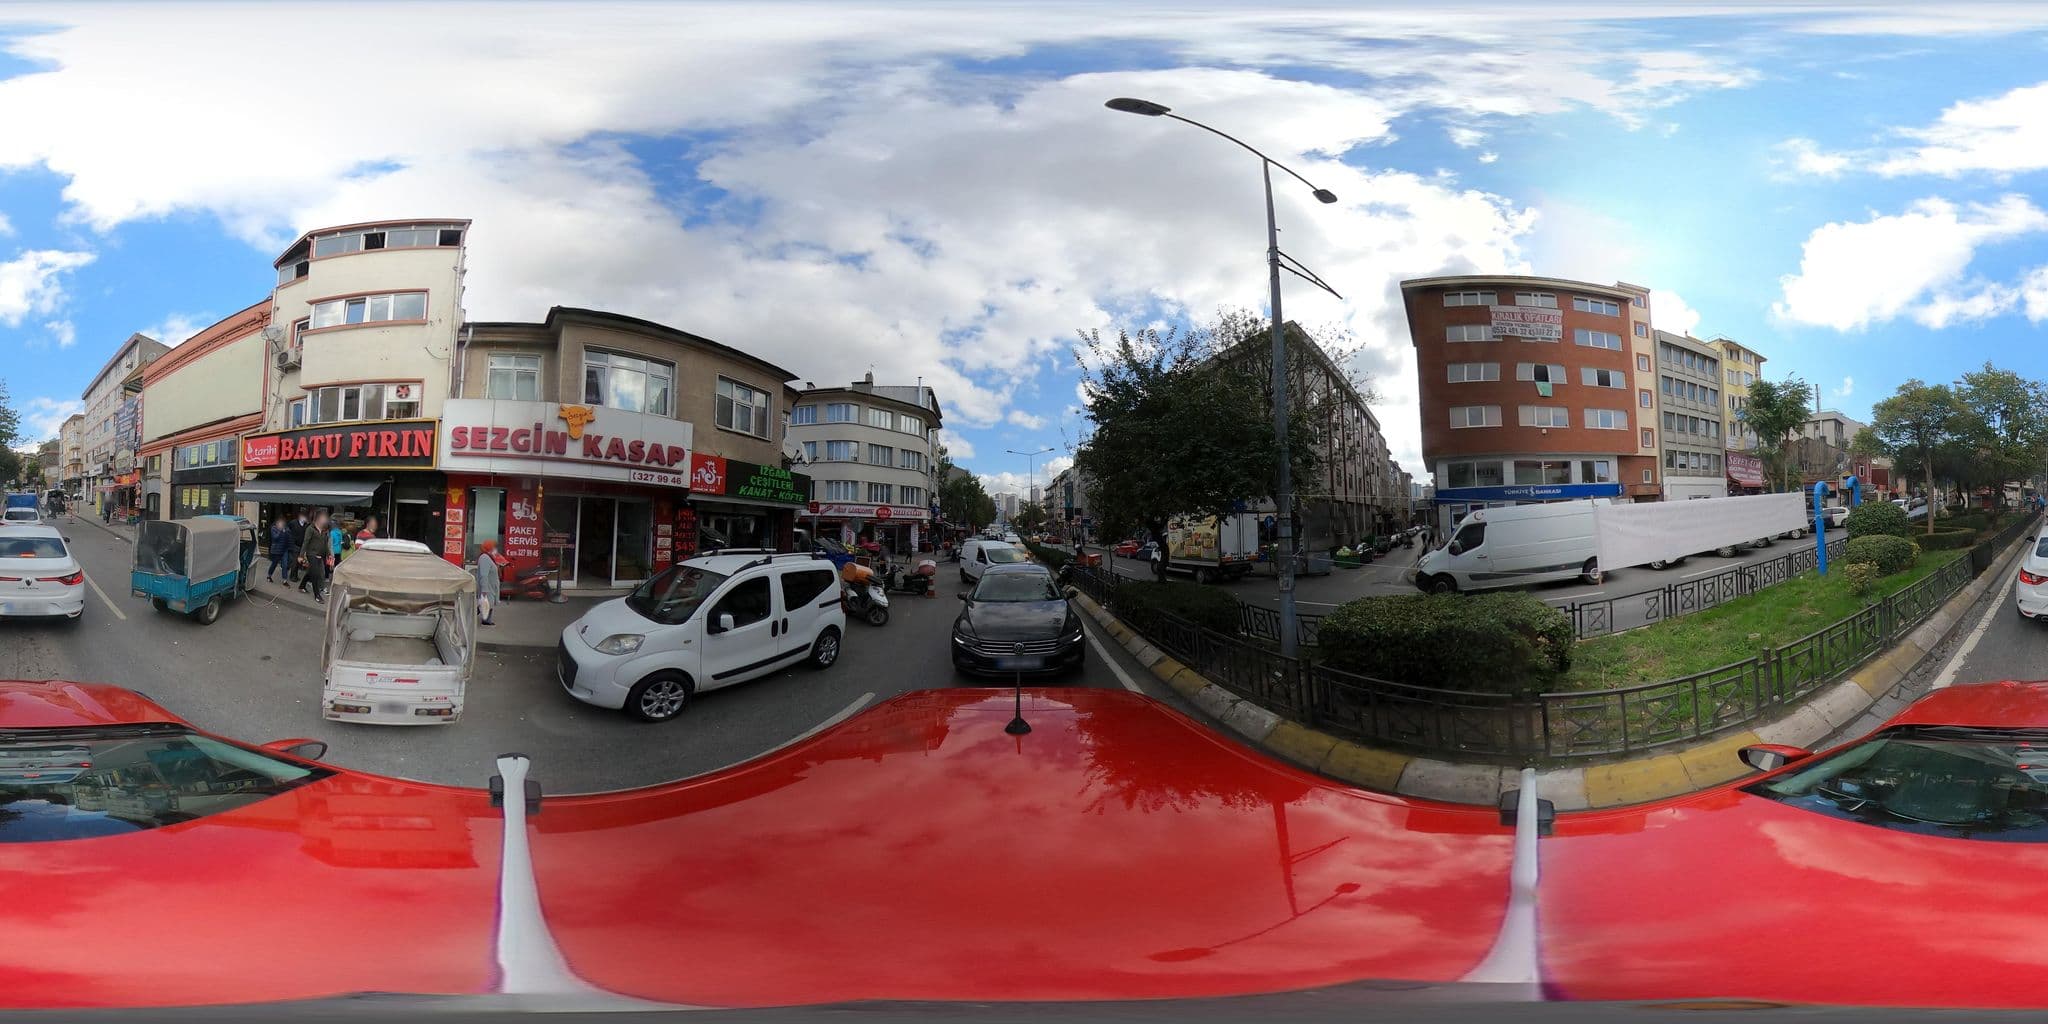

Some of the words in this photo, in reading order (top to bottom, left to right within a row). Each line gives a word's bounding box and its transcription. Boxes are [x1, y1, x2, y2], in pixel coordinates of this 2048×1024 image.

[280, 433, 342, 461] BATU
[349, 429, 433, 458] FIRIN
[451, 422, 568, 455] SEZGİN
[583, 433, 685, 466] KASAP
[637, 472, 655, 482] 327
[657, 474, 669, 483] 99
[671, 476, 682, 485] 46
[509, 526, 537, 536] PAKET
[508, 536, 538, 546] SERVİS
